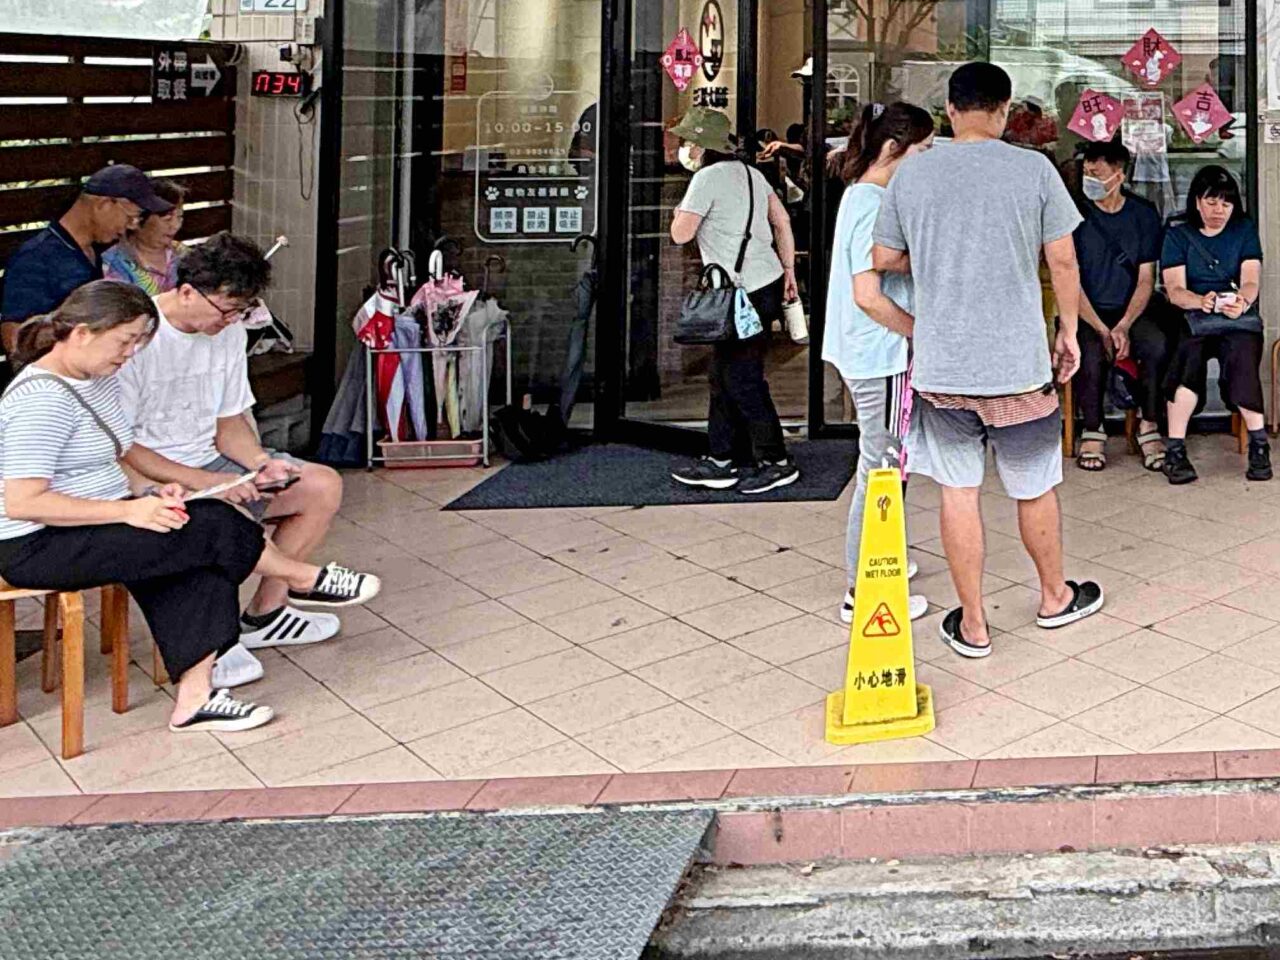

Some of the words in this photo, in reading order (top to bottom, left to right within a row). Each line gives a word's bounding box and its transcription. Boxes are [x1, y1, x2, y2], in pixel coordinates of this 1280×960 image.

[1082, 95, 1106, 114] 旺
[1196, 91, 1214, 112] 吉
[484, 121, 592, 134] 10:00-1500
[868, 557, 898, 567] CAUTION
[865, 570, 878, 579] WET
[880, 568, 901, 578] FLOOR
[854, 667, 906, 691] 小心地滑
